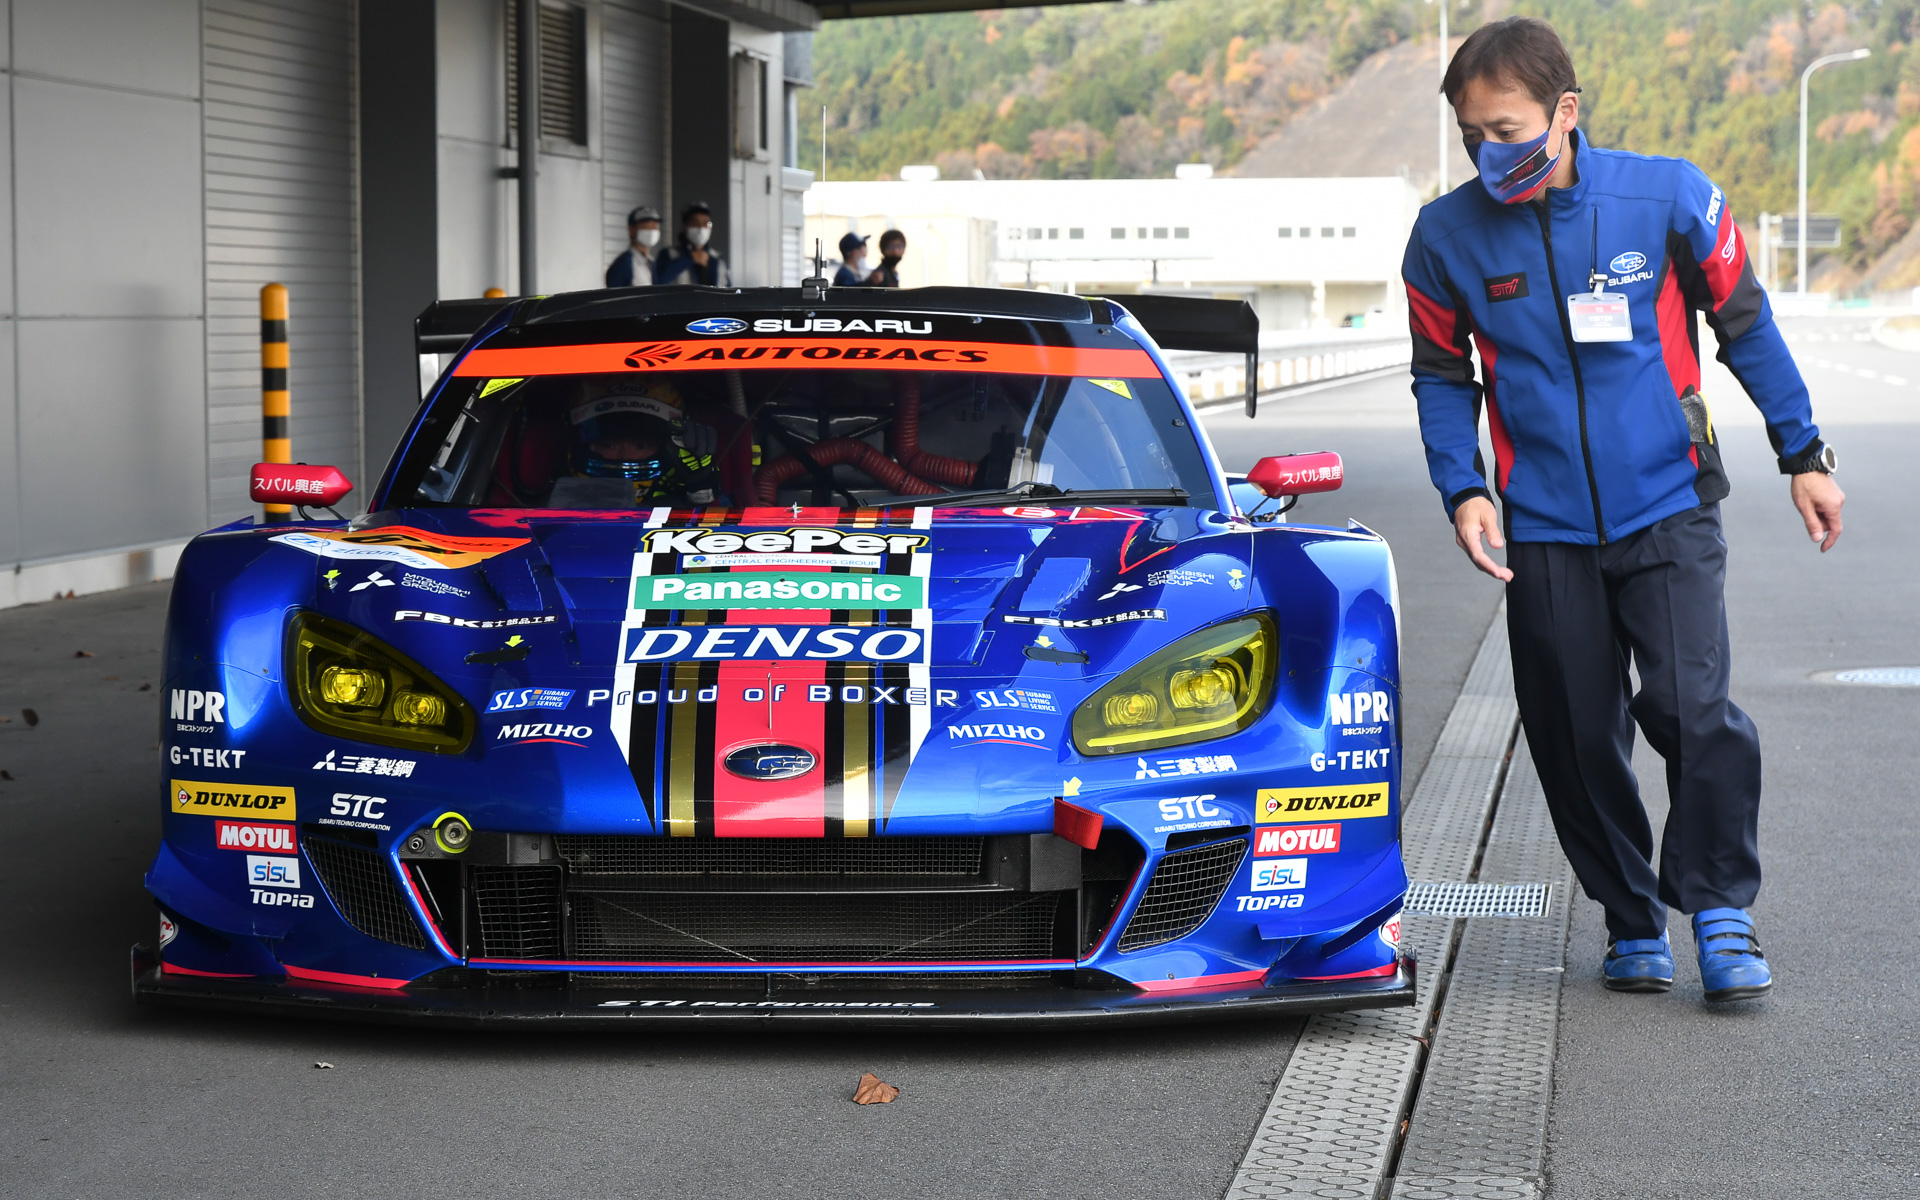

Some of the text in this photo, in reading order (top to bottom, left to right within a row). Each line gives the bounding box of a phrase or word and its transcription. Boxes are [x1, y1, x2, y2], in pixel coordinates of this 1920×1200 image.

[1607, 270, 1654, 287] SUBARU
[753, 318, 933, 334] SUBARU
[684, 346, 988, 363] AUTOBACS
[616, 401, 660, 412] SUBARU
[1281, 465, 1342, 486] スバル興産
[254, 477, 324, 495] スバル興産
[646, 529, 923, 553] KeePer
[404, 572, 471, 596] MITSUBISHI
[1147, 569, 1215, 580] MITSUBISHI
[1147, 574, 1214, 585] CHEMICAL
[1148, 579, 1194, 587] GROUP
[401, 580, 447, 595] GROUP
[652, 577, 902, 602] Panasonic
[394, 610, 556, 628] FBK 富士部品工業
[1004, 608, 1167, 628] FBK 富士部品工業
[628, 627, 921, 660] DENSO
[490, 689, 533, 711] SLS
[543, 689, 571, 697] SUBARU
[587, 684, 960, 708] Proud of BOXER
[975, 689, 1020, 708] SLS
[1025, 691, 1052, 700] SUBARU
[1027, 697, 1051, 705] LIVING
[170, 688, 225, 723] NPR
[1030, 703, 1057, 712] SERVICE
[1329, 690, 1390, 726] NPR
[496, 723, 593, 739] MIZUHO
[947, 723, 1046, 741] MIZUHO
[170, 745, 247, 769] G-TEKT
[336, 755, 416, 778] 三菱製鋼
[1156, 754, 1238, 778] 三菱製鋼
[1310, 748, 1391, 772] G-TEKT
[194, 791, 287, 810] DUNLOP
[330, 792, 387, 820] STC
[1158, 794, 1220, 822] STC
[1284, 793, 1382, 812] DUNLOP
[355, 821, 391, 831] CORPORATION
[1175, 822, 1197, 830] TECHNO
[1197, 819, 1231, 828] CORPORATION
[220, 825, 294, 850] MOTUL
[1257, 827, 1337, 853] MOTUL
